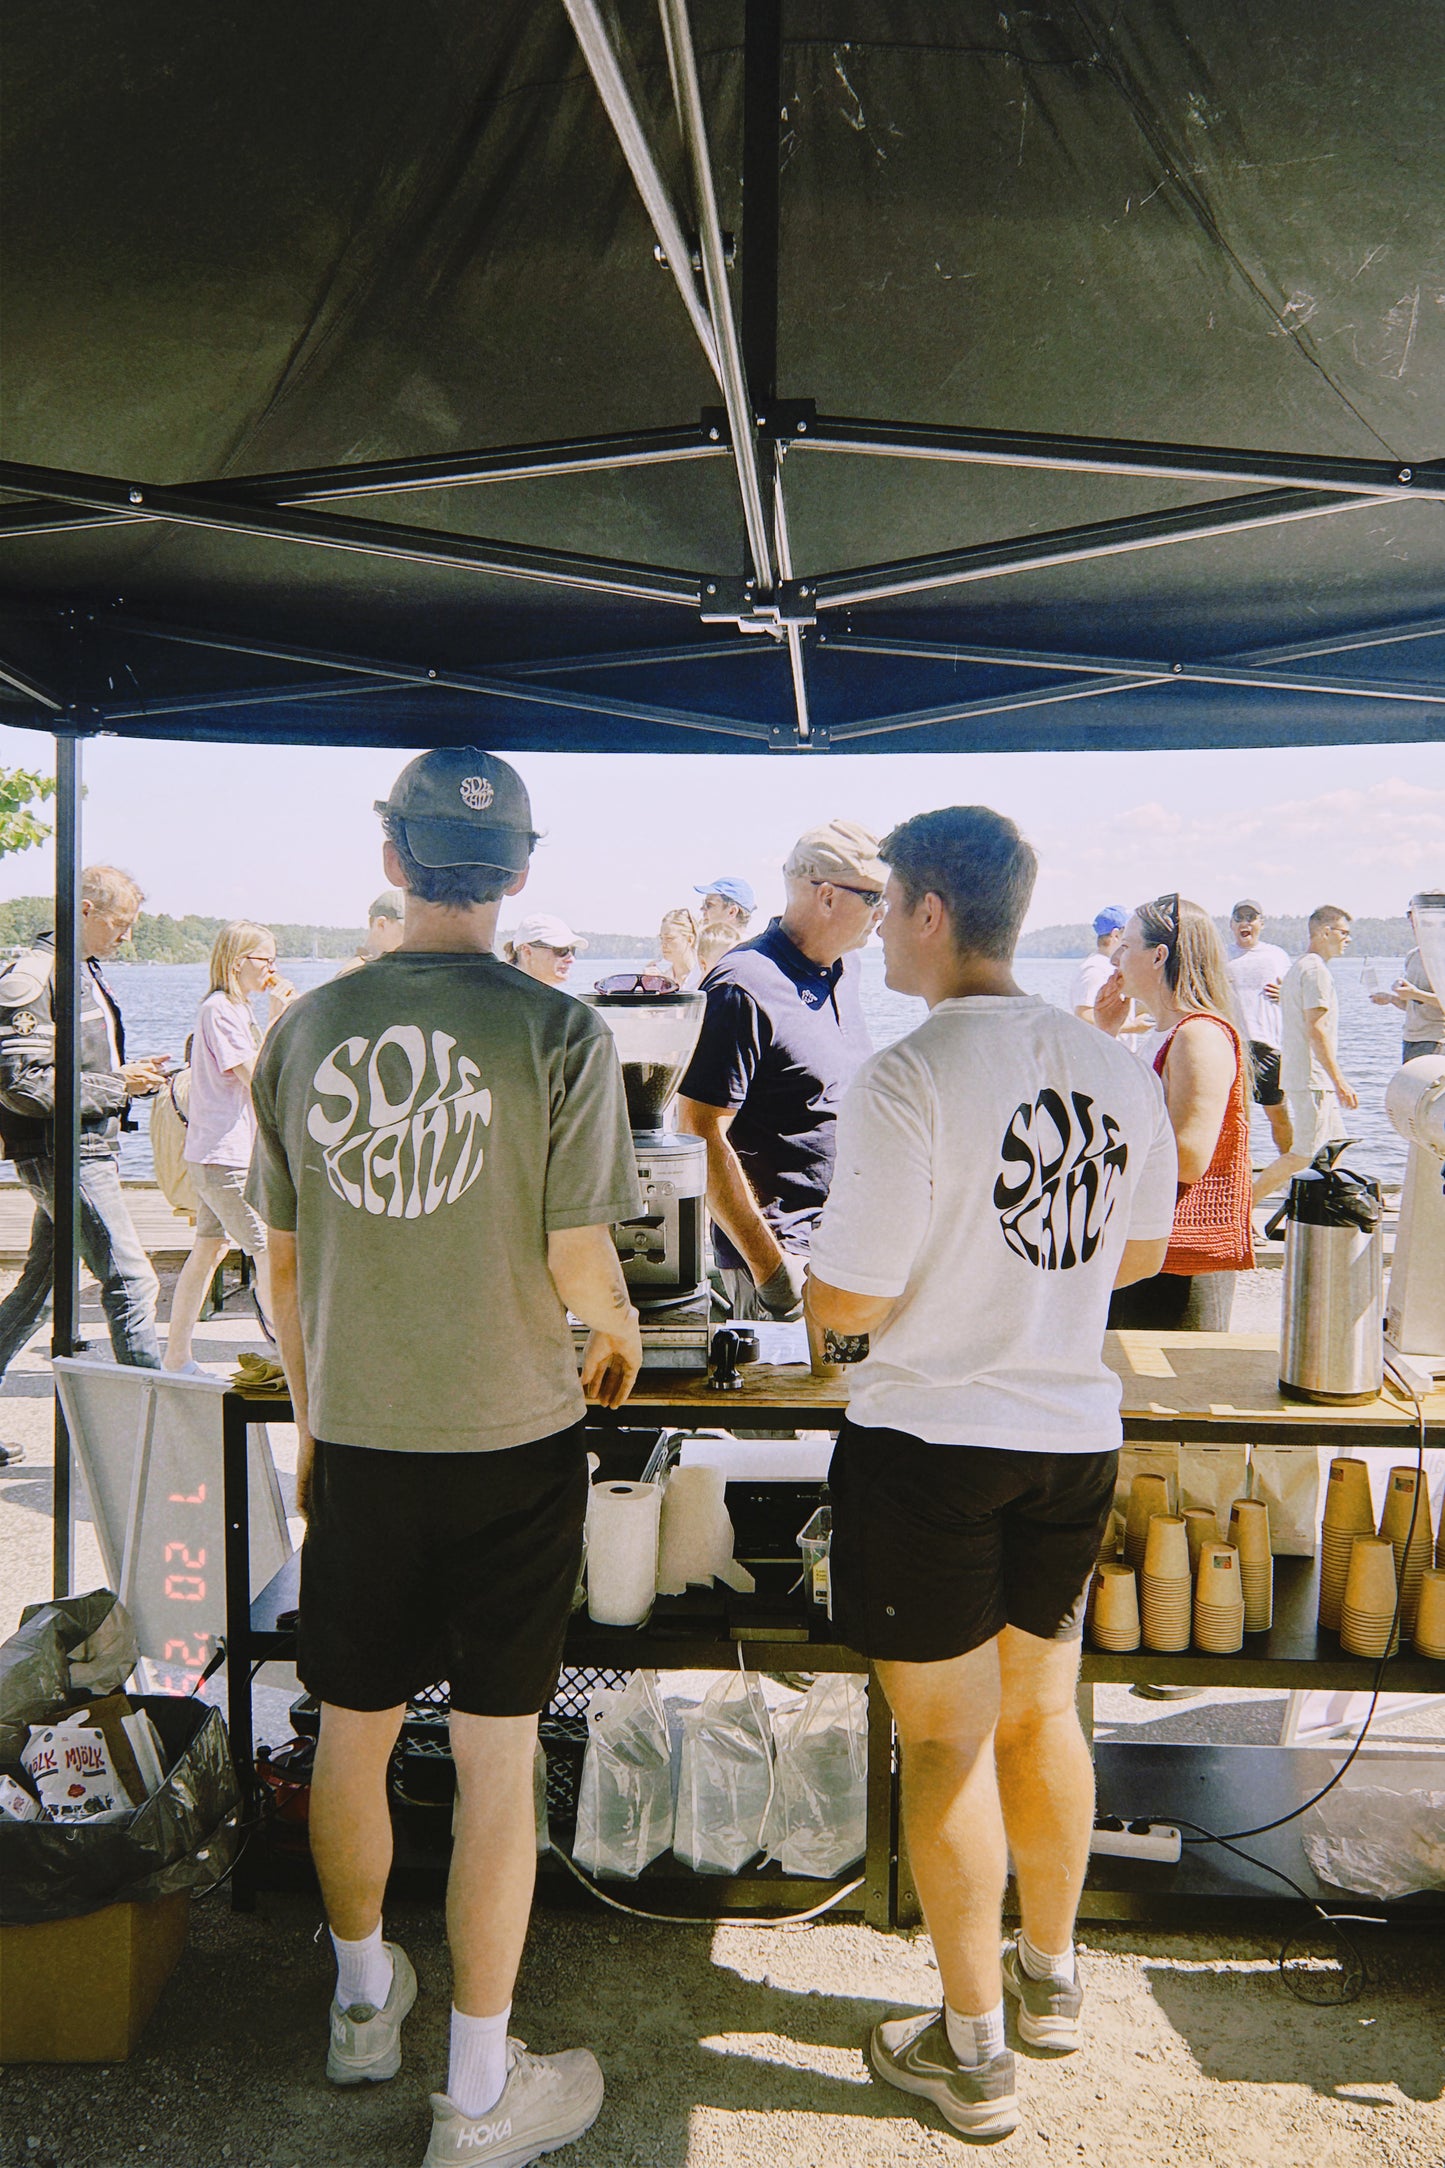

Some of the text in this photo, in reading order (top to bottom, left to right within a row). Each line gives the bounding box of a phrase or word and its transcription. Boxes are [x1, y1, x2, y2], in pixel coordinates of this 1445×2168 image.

[25, 1749, 58, 1777] ÖLK
[65, 1745, 105, 1772] MJÖLK
[456, 2117, 512, 2149] HOKA
